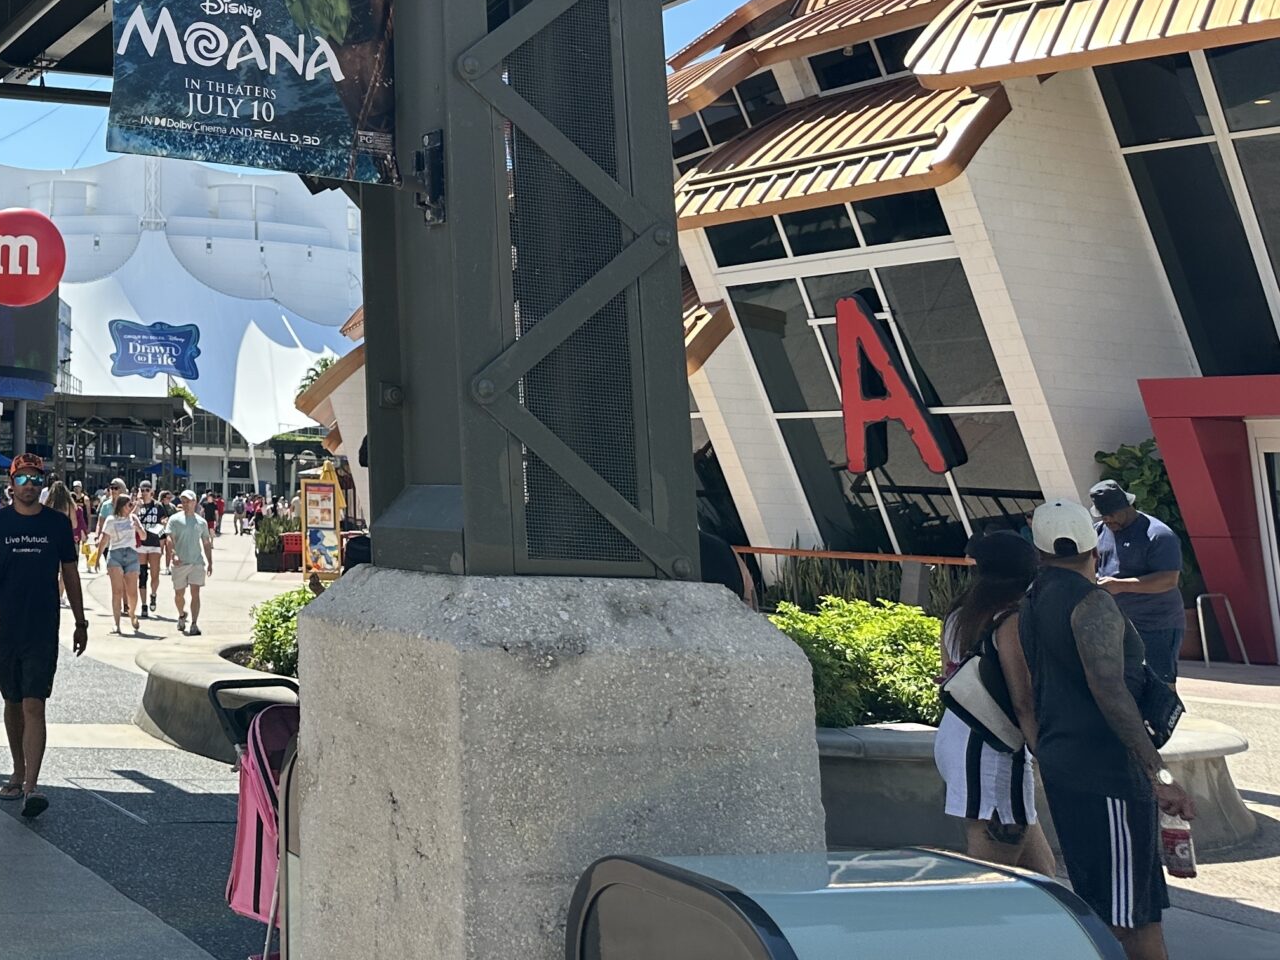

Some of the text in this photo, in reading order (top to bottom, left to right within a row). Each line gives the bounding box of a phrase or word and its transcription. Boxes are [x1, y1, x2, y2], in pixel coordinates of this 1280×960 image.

[116, 4, 345, 82] MOANA
[185, 77, 277, 100] IN THEATERS
[186, 92, 275, 122] JULY 10
[140, 115, 152, 125] IN
[167, 118, 192, 130] Dolby
[193, 122, 227, 134] Cinema
[229, 127, 252, 138] AND
[128, 340, 181, 357] Drawn
[148, 353, 177, 366] Life
[835, 294, 948, 474] A
[5, 536, 20, 544] Live
